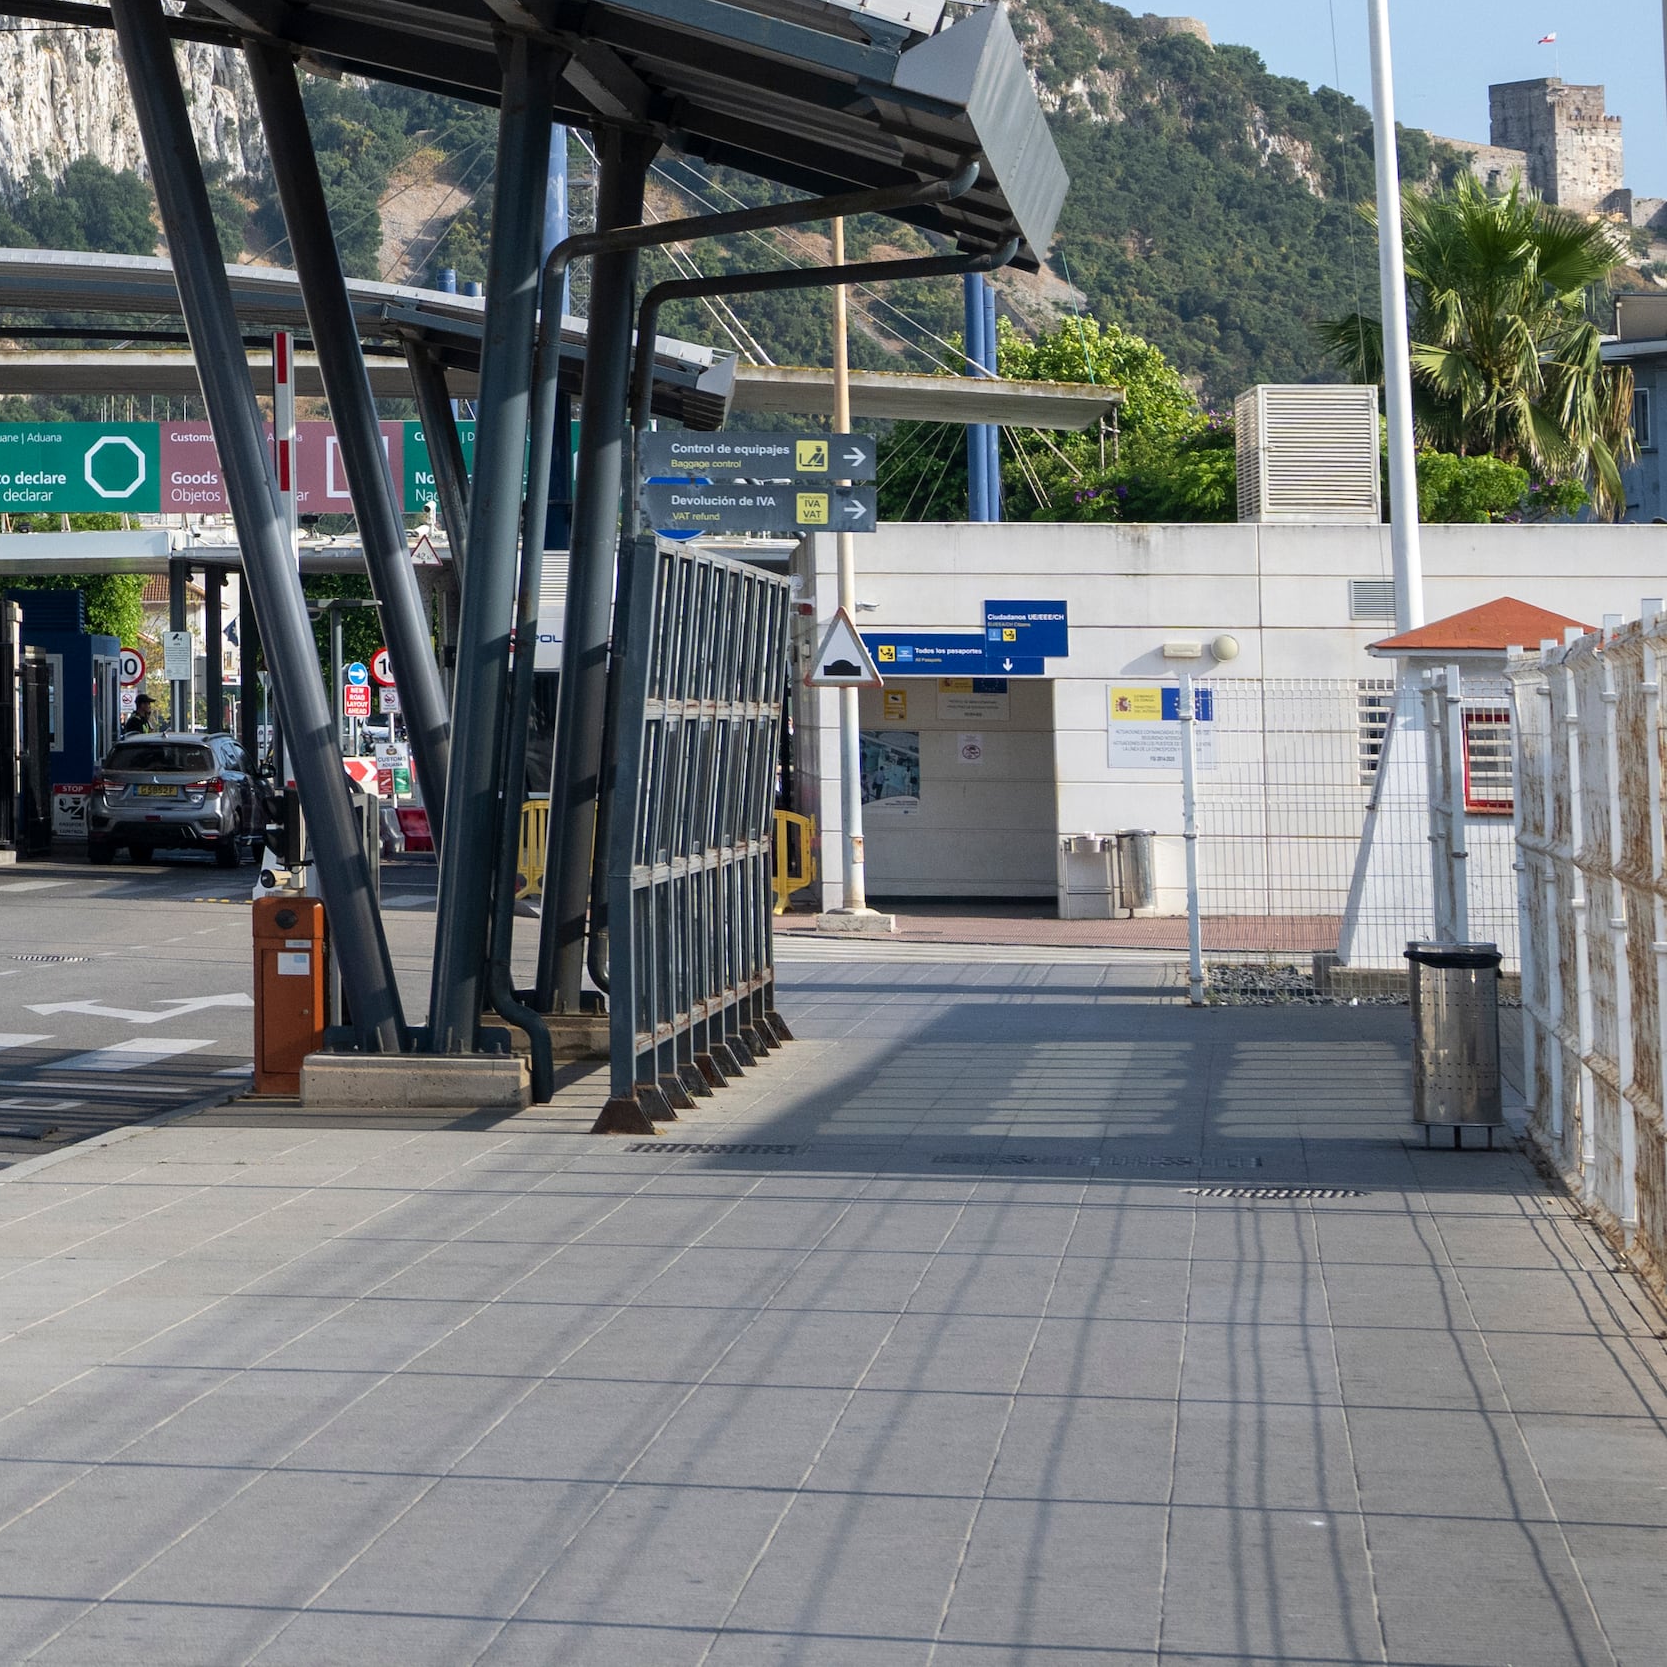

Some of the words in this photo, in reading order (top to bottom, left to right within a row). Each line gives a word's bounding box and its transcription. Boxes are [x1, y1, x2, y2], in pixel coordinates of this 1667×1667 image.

[26, 432, 62, 443] Aduana
[671, 443, 714, 454] Control
[717, 443, 730, 454] de
[734, 444, 790, 457] equipajes
[671, 459, 710, 470] Baggage
[712, 459, 742, 469] control
[14, 471, 66, 484] declare
[171, 471, 217, 484] Goods
[3, 488, 53, 502] declarar
[171, 488, 220, 505] Objetos
[671, 495, 735, 507] Devolución
[739, 496, 753, 507] de
[756, 496, 776, 507] IVA
[804, 499, 821, 508] IVA
[672, 512, 690, 521] VAT
[692, 512, 721, 521] refund
[803, 510, 823, 519] VAT
[987, 613, 1027, 621] Ciudadanos
[947, 648, 983, 656] pasaportes
